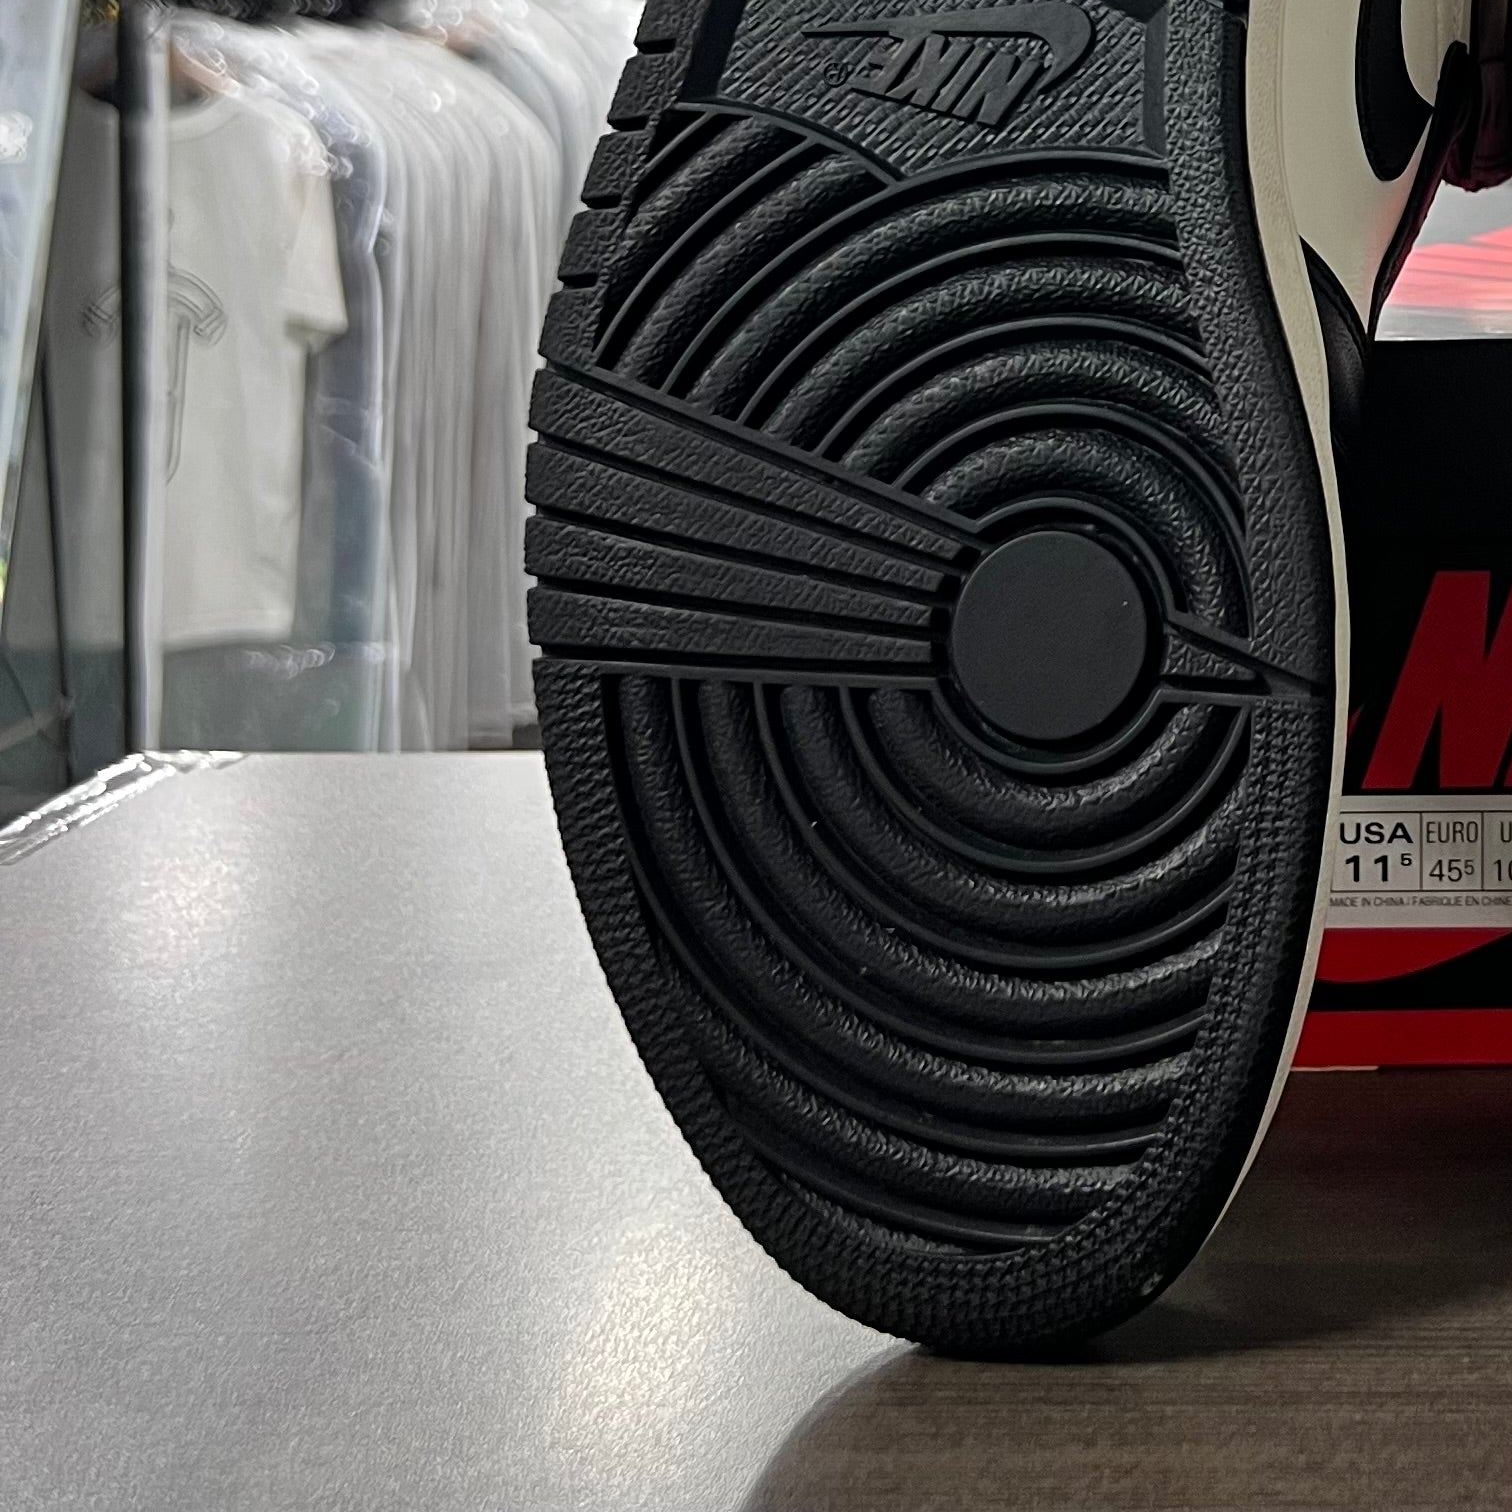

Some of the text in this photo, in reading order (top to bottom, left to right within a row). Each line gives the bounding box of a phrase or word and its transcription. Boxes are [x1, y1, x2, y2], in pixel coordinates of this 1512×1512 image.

[850, 32, 1044, 129] NIKE
[1339, 821, 1414, 844] USA
[1426, 820, 1479, 844] EURO
[1329, 896, 1358, 907] MADE
[1465, 896, 1480, 907] EN
